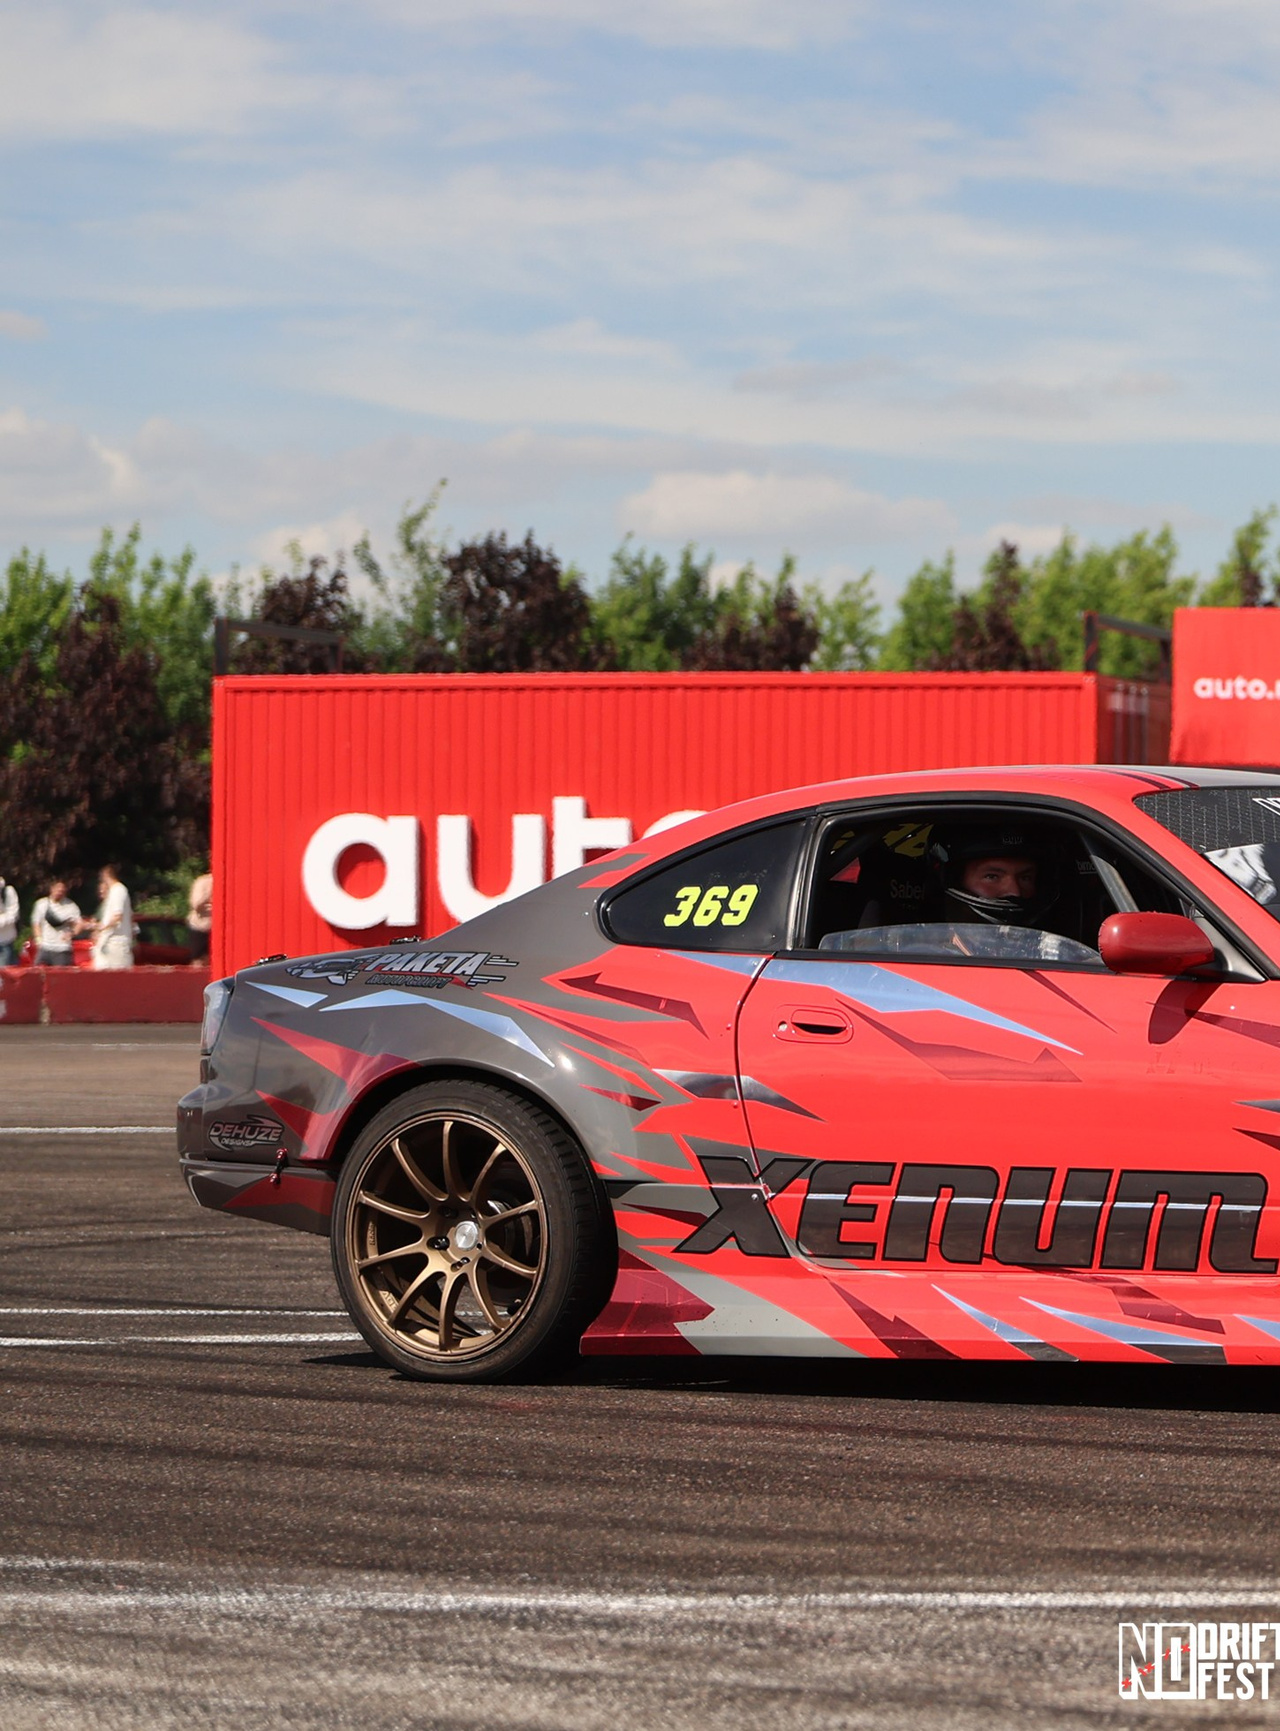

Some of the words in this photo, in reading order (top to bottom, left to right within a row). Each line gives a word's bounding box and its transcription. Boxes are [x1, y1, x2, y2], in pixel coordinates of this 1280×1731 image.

[302, 796, 708, 930] aut
[663, 883, 759, 927] 369
[208, 1122, 283, 1141] DEHUZE
